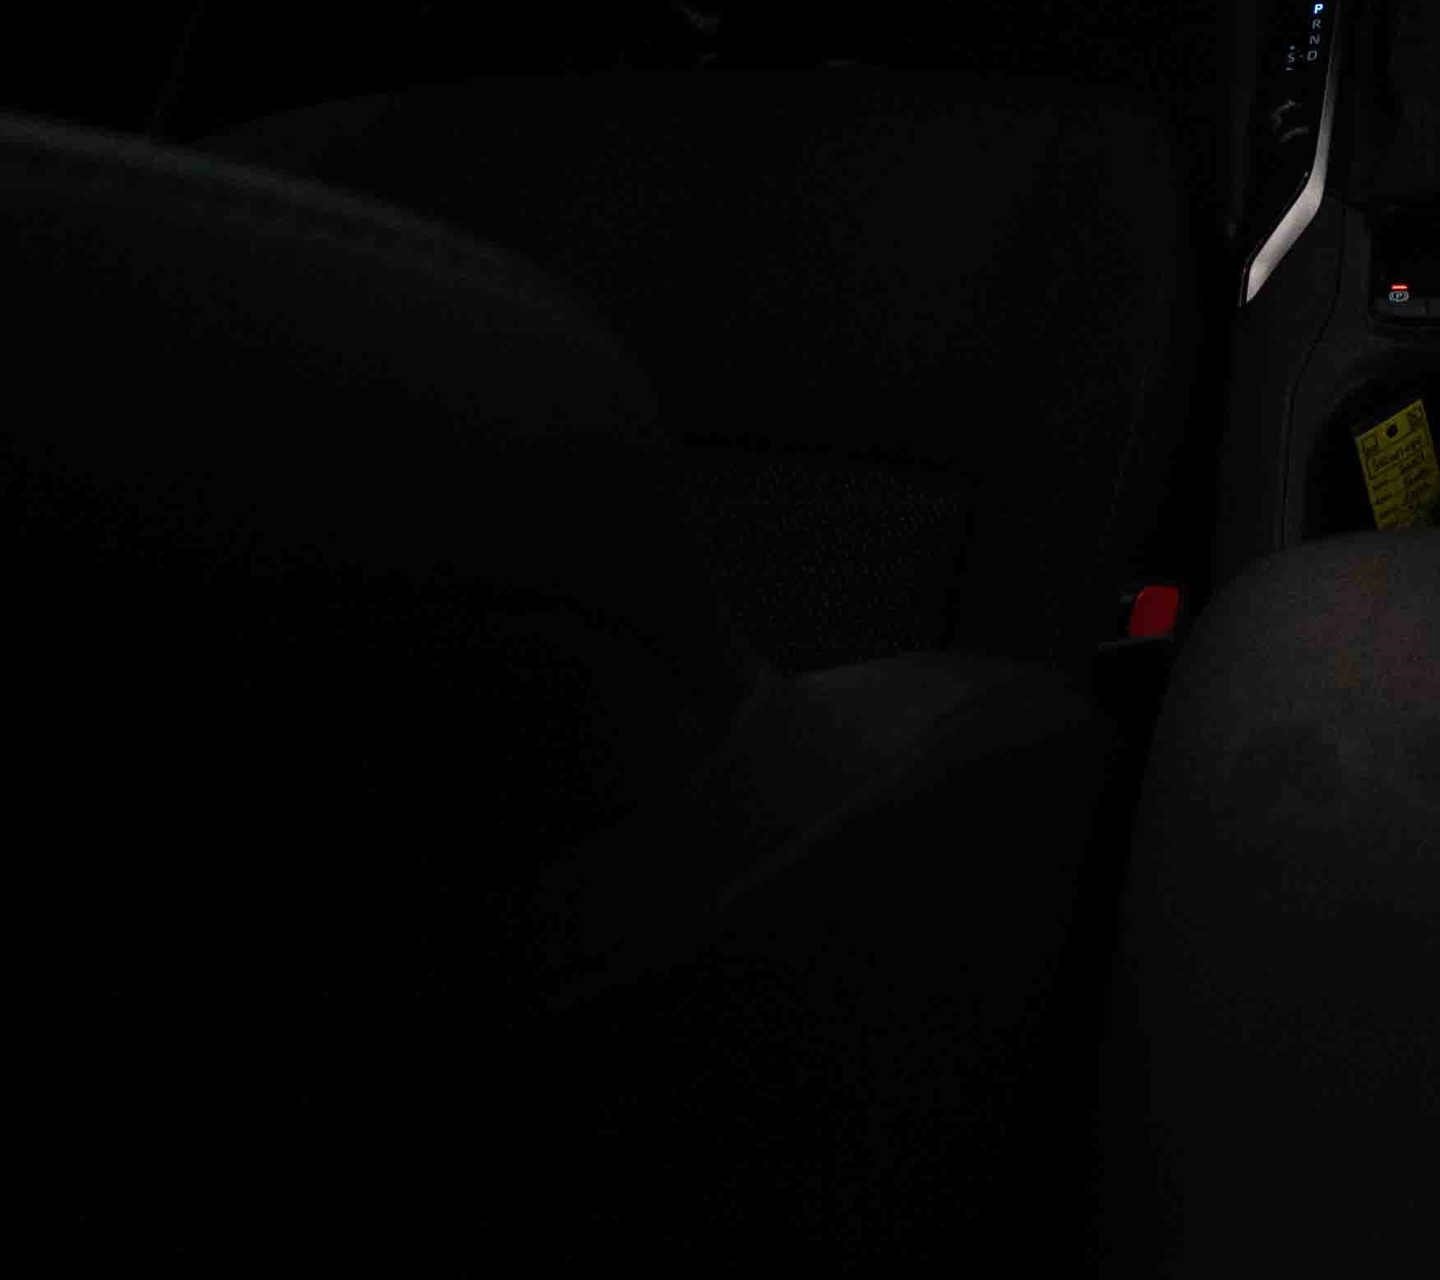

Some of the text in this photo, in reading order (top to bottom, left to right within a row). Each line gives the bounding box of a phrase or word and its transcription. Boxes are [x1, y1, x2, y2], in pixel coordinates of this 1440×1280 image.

[1312, 2, 1325, 15] P
[1311, 18, 1322, 31] R
[1308, 33, 1321, 46] N
[1286, 48, 1318, 64] S D
